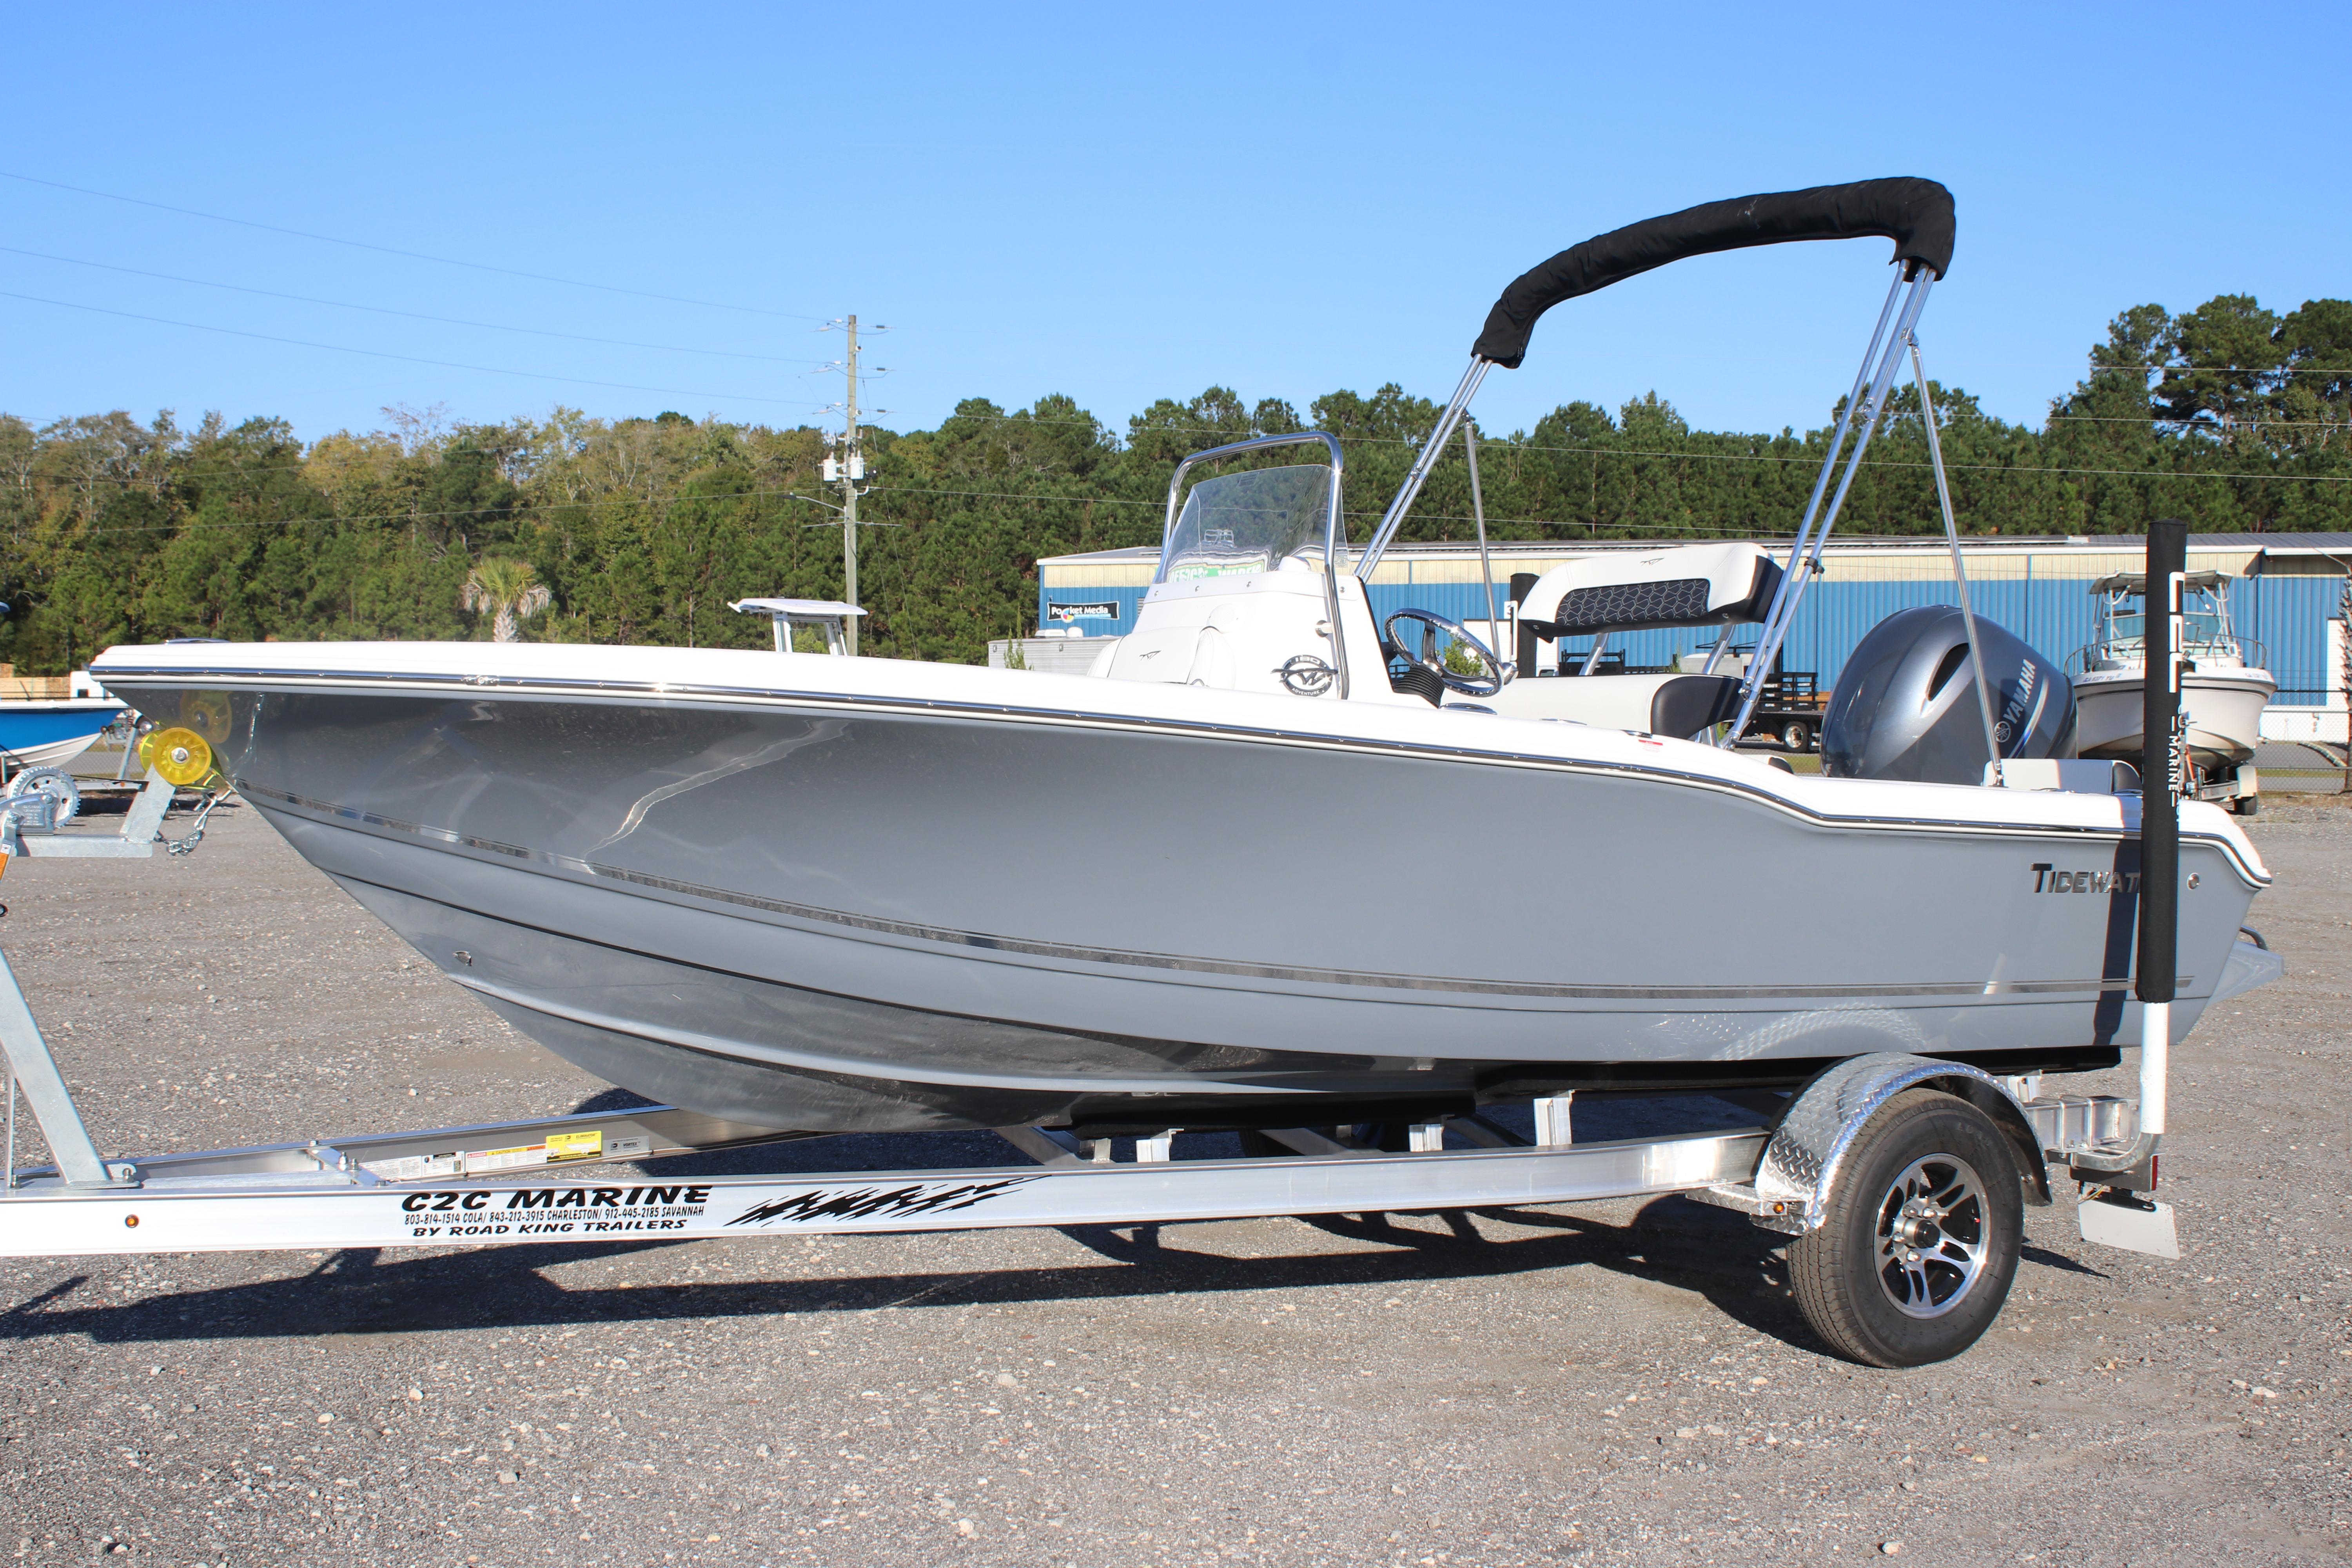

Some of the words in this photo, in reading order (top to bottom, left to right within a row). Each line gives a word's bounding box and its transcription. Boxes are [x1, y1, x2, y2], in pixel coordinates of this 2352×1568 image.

[1084, 606, 1109, 614] Media
[2003, 659, 2036, 724] YAMAHA
[2168, 735, 2179, 791] MARINE
[402, 1191, 491, 1212] C2C
[507, 1185, 713, 1209] MARINE
[405, 1213, 460, 1225] 803-814-1514
[463, 1212, 487, 1224] COLA/
[490, 1210, 545, 1223] 843-212-3915
[547, 1208, 602, 1221] CHARLESTON/
[605, 1207, 659, 1220] 912-445-2185
[662, 1205, 705, 1218] SAVANNAH
[413, 1227, 441, 1237] BY
[449, 1225, 510, 1236] ROAD
[518, 1222, 575, 1233] KING
[583, 1219, 688, 1232] TRAILERS
